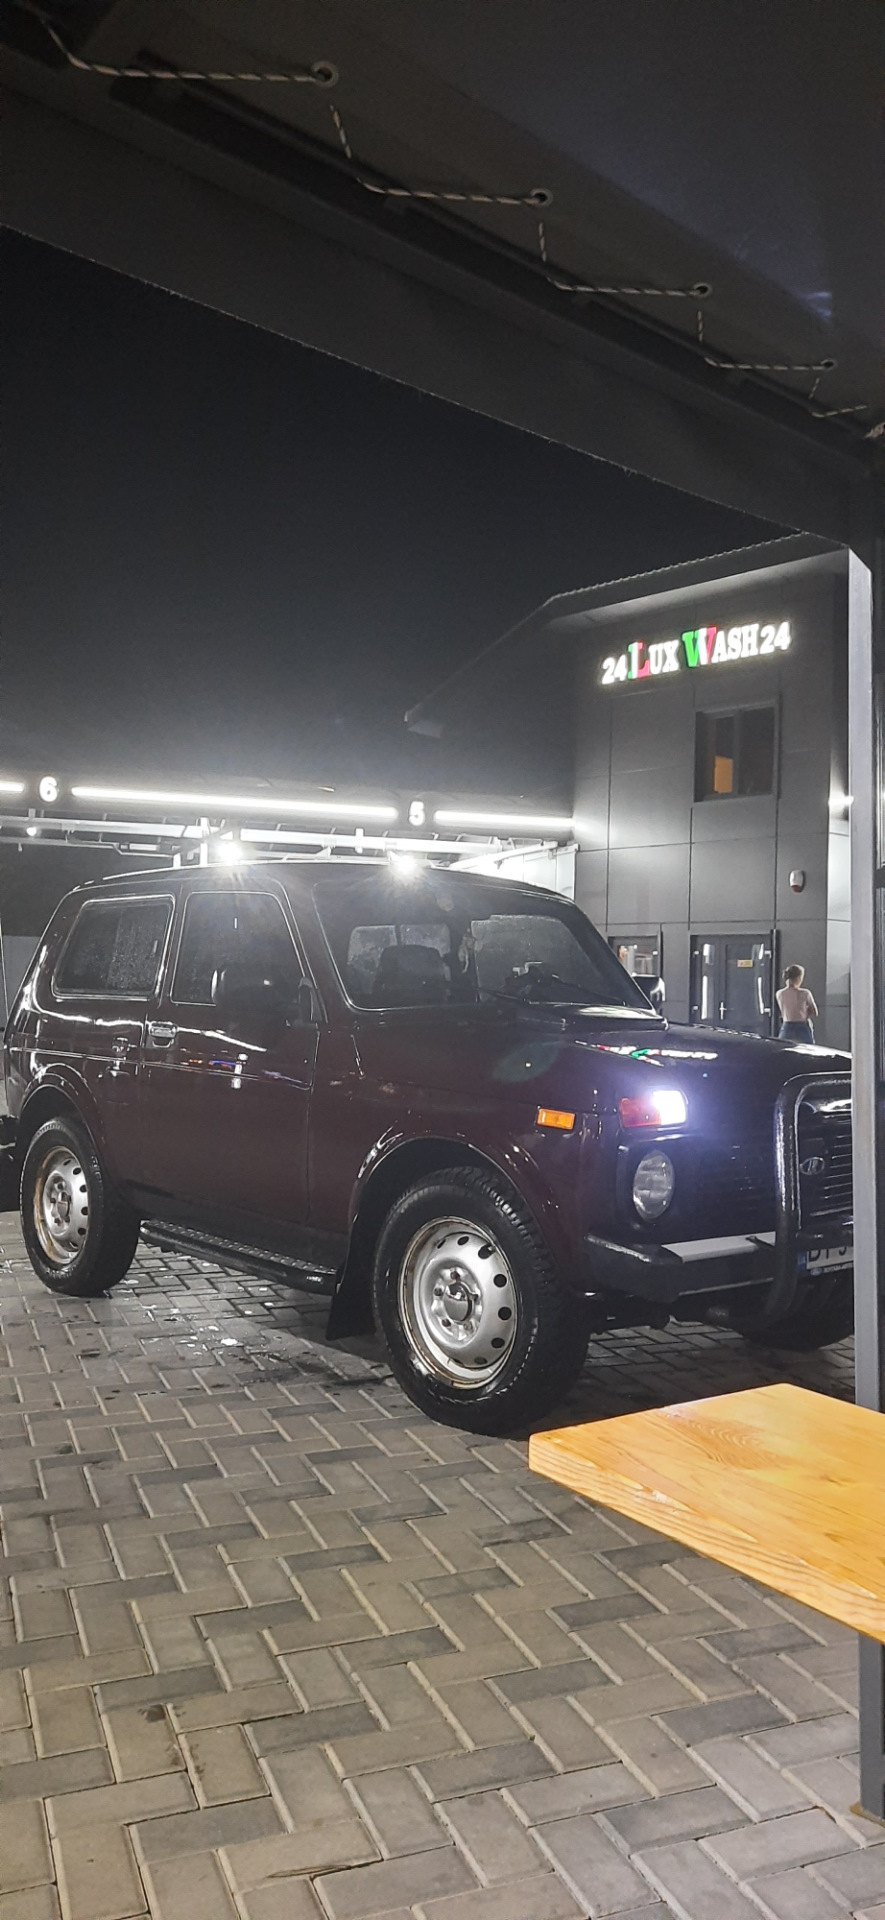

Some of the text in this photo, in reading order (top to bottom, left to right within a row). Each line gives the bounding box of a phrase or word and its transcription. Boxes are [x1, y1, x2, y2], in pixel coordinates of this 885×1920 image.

[602, 621, 791, 684] 24 LUX WASH 24
[39, 776, 58, 802] 6
[409, 800, 425, 826] 5
